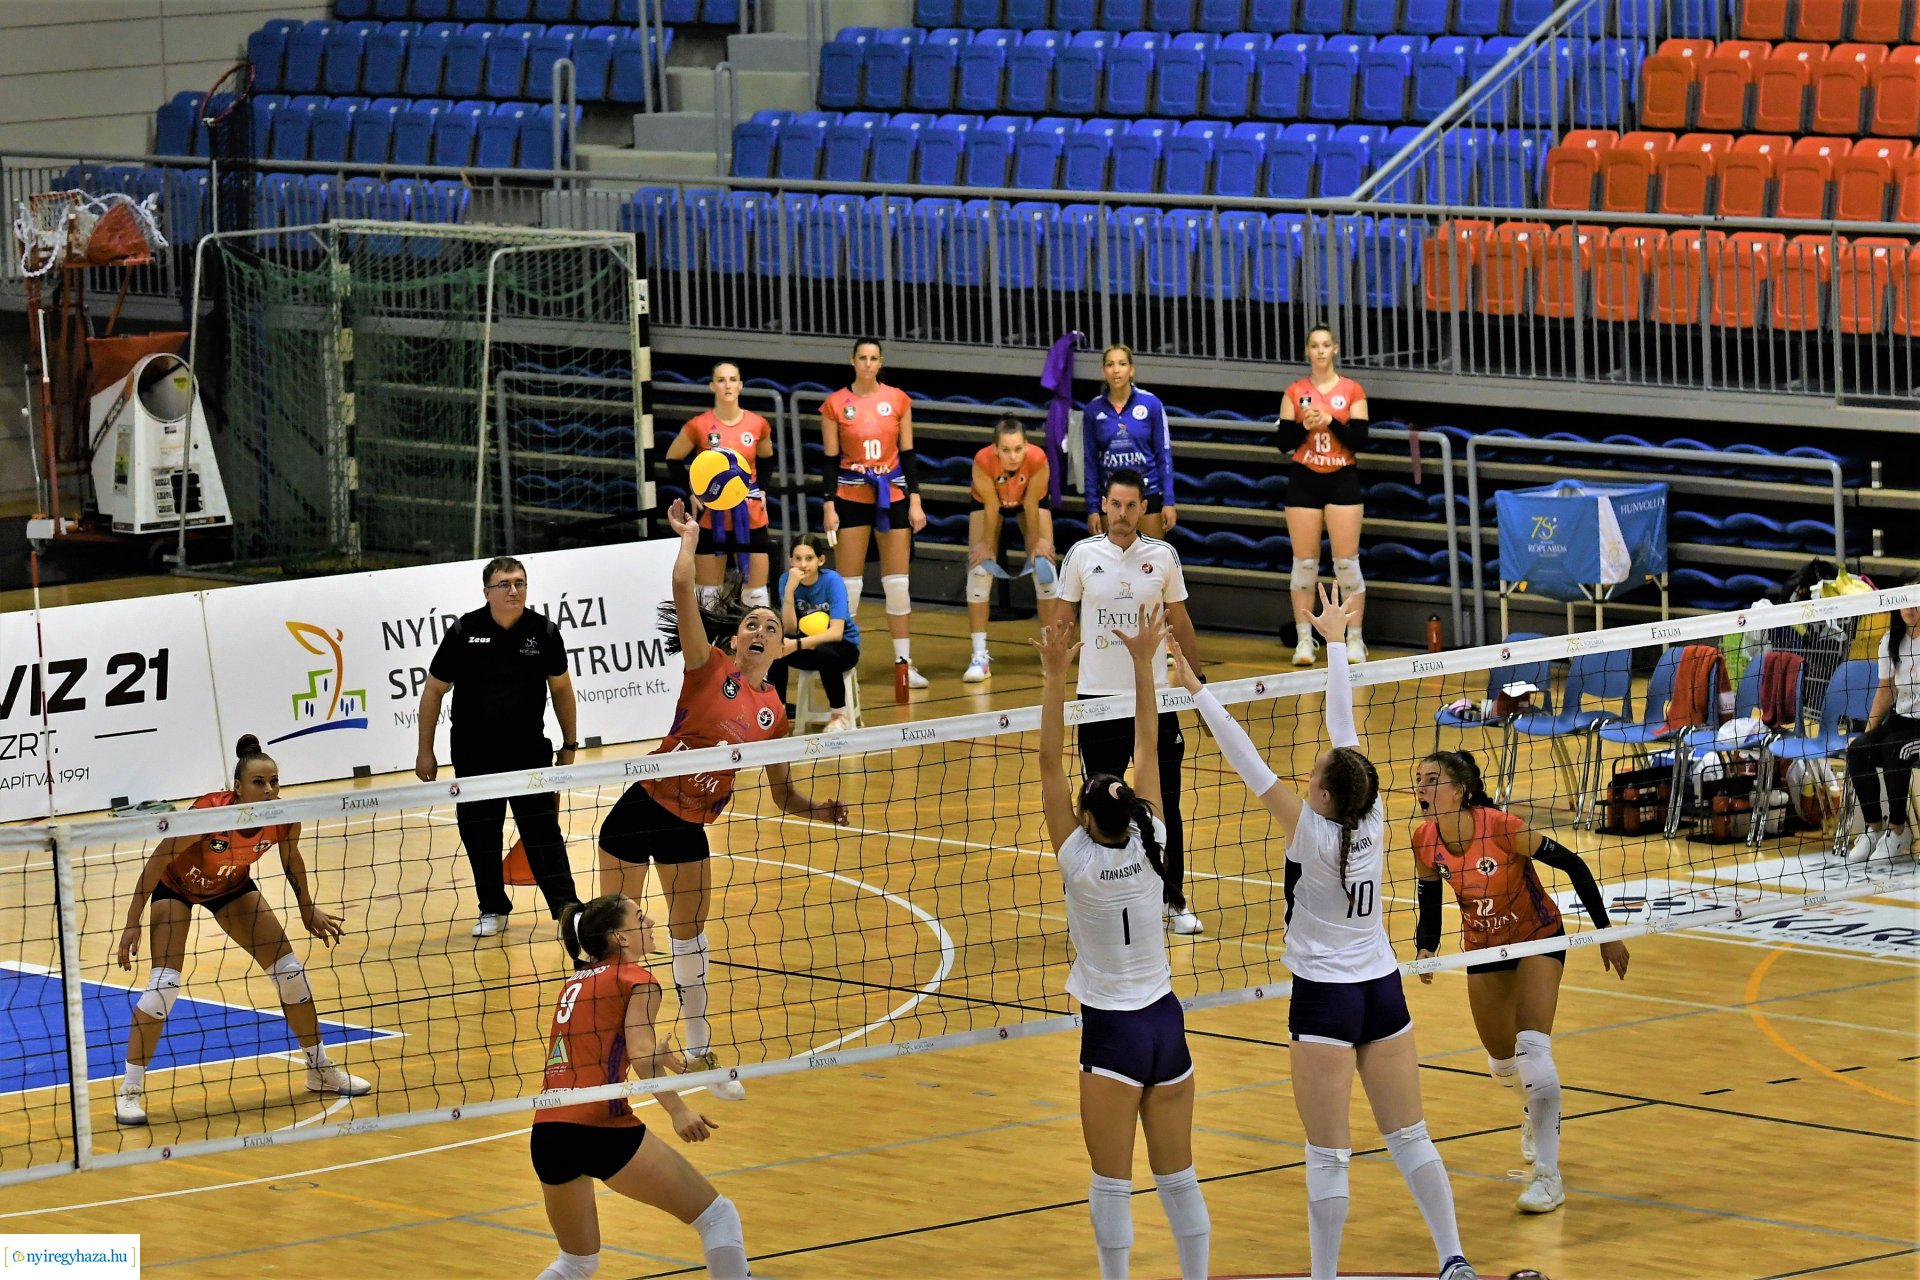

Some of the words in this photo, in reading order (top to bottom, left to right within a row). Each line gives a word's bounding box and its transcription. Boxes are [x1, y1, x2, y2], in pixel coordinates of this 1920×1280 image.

[863, 439, 881, 460] 10
[1314, 432, 1331, 453] 13
[1104, 451, 1147, 466] FATUM
[1879, 594, 1908, 606] FATUM
[468, 636, 491, 644] Zeus
[1651, 627, 1681, 639] FATUM
[1412, 660, 1444, 673] FATUM
[105, 648, 169, 708] 21
[577, 682, 643, 703] Nonprofit
[645, 680, 670, 695] Kft.
[1161, 694, 1195, 708] FATUM
[901, 728, 936, 741] FATUM
[0, 730, 59, 760] ZRT.
[58, 767, 90, 784] 1991
[624, 762, 660, 776] FATUM
[341, 796, 378, 811] FATUM
[1346, 880, 1373, 919] 10
[1804, 895, 1827, 905] FATUM
[1122, 907, 1131, 946] 1
[1569, 936, 1594, 946] FATUM
[556, 983, 583, 1024] 9
[809, 1057, 838, 1068] FATUM
[532, 1097, 562, 1109] FATUM
[243, 1136, 274, 1147] FATUM
